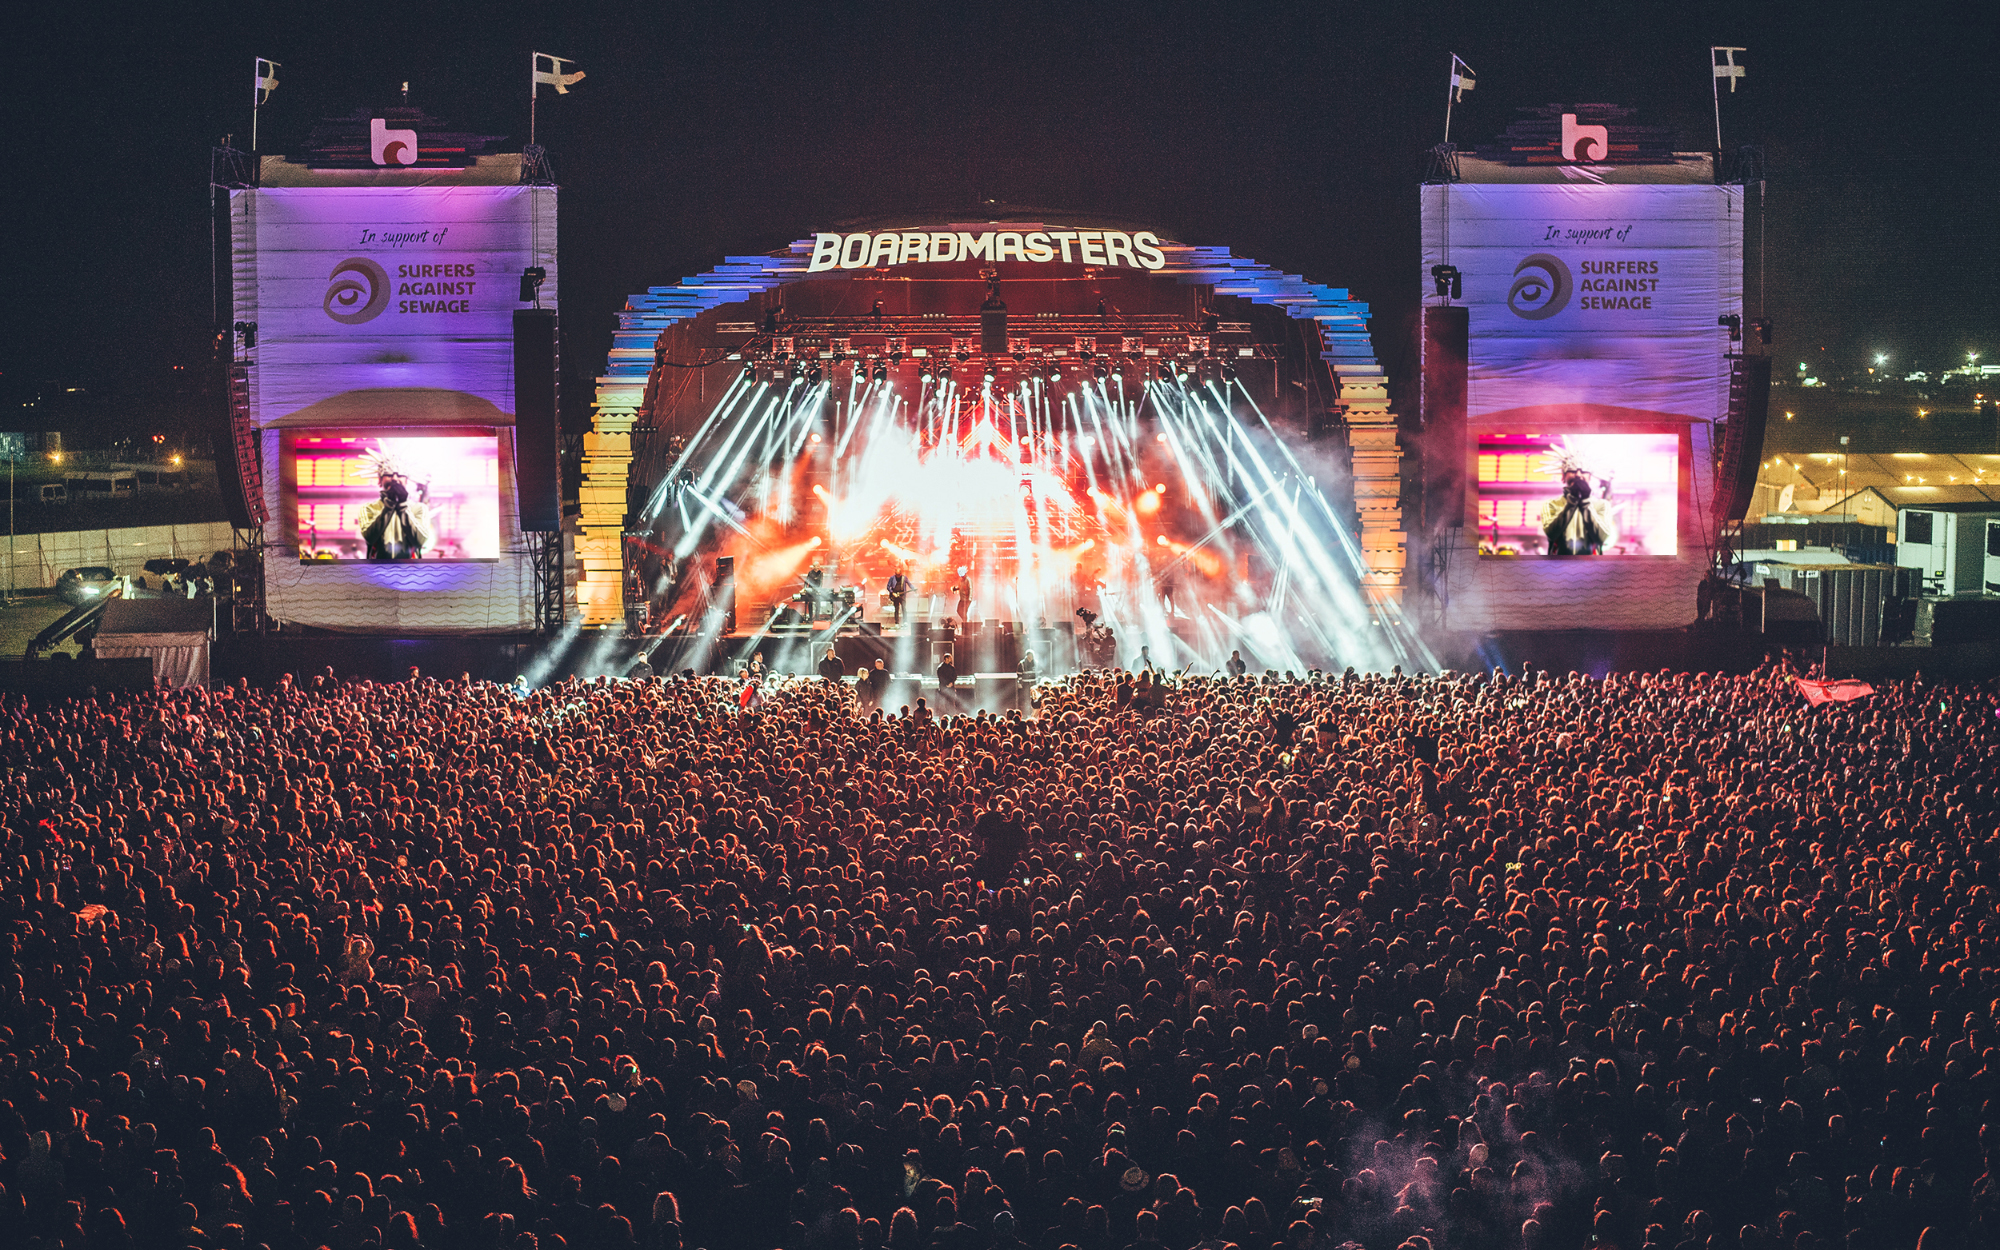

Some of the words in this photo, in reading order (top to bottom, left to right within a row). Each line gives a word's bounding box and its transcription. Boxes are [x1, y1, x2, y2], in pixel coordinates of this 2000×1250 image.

[360, 229, 376, 244] In
[381, 230, 429, 248] support
[433, 227, 448, 245] of
[1544, 225, 1560, 240] In
[1565, 227, 1614, 245] support
[1617, 225, 1632, 242] of
[807, 231, 1166, 273] BOARDMASTERS
[398, 264, 475, 278] SURFERS
[1581, 261, 1659, 274] SURFERS
[398, 282, 476, 295] AGAINST
[1580, 279, 1659, 292] AGAINST
[399, 300, 470, 313] SEWAGE
[1581, 297, 1652, 310] SEWAGE
